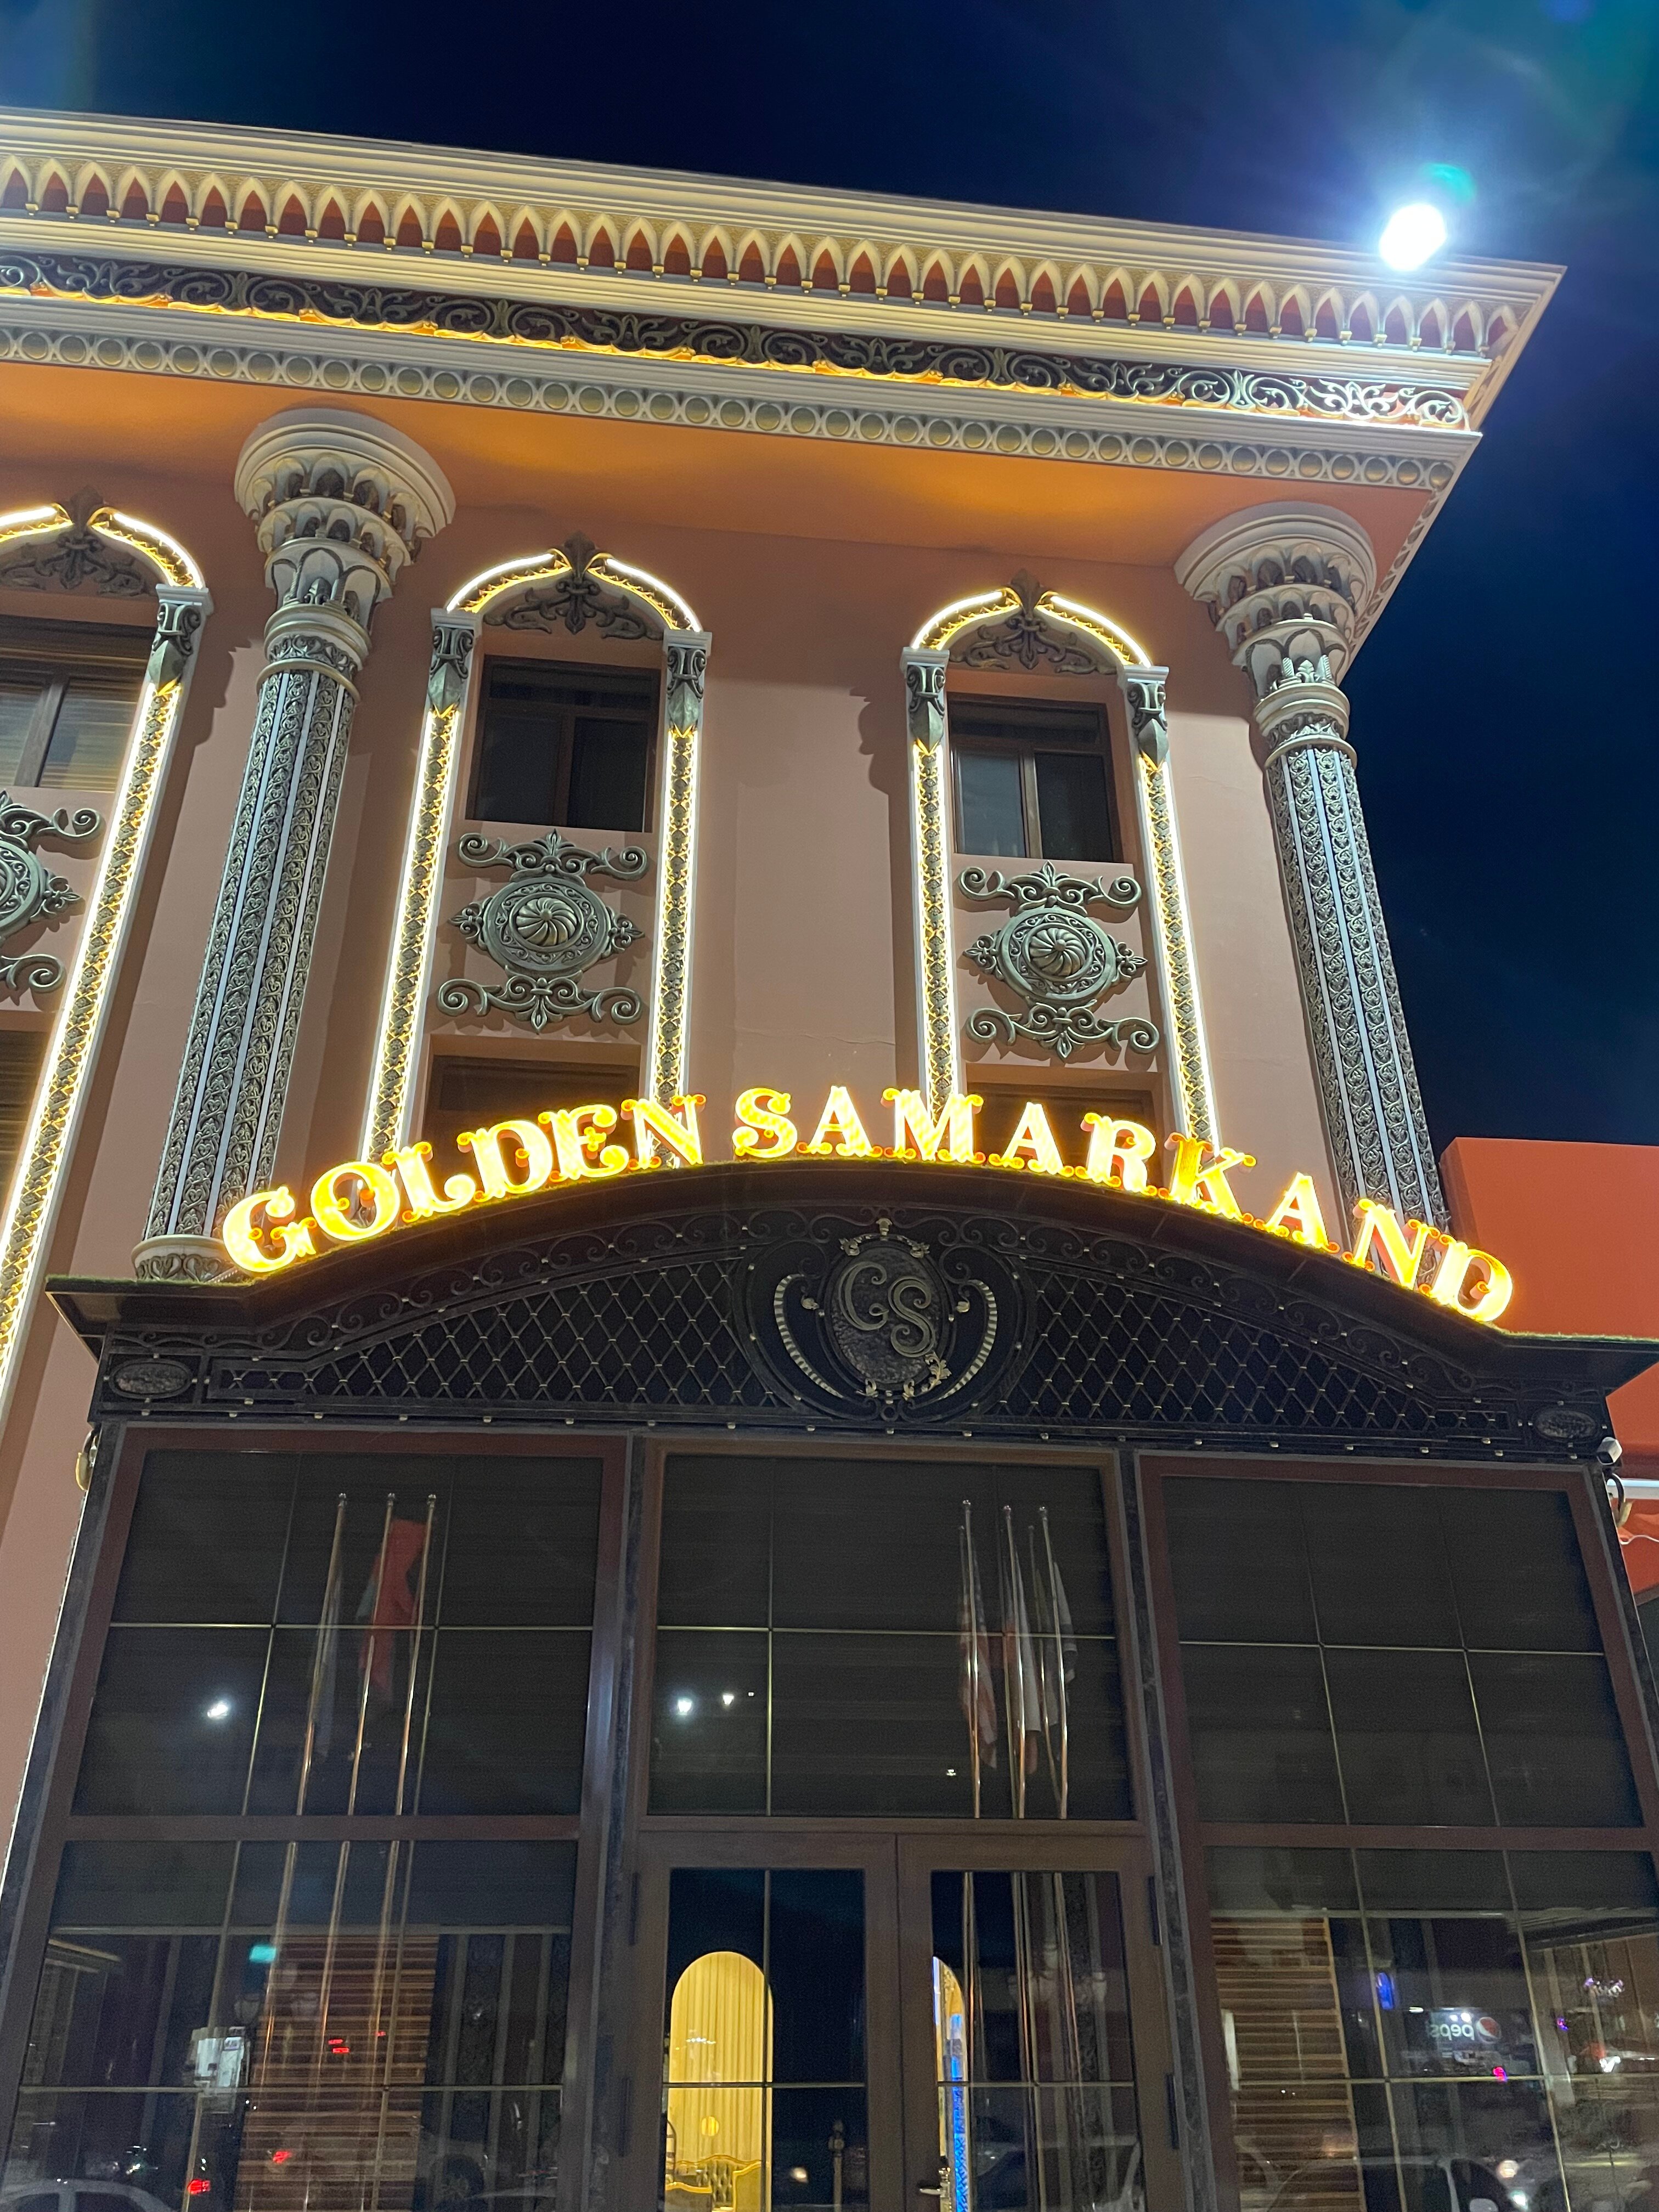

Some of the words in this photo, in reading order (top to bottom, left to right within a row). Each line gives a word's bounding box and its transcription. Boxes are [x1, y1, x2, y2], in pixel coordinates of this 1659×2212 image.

[222, 1093, 707, 1273] GOLDEN
[732, 1085, 1514, 1323] SAMARKAND
[838, 1261, 936, 1358] GS
